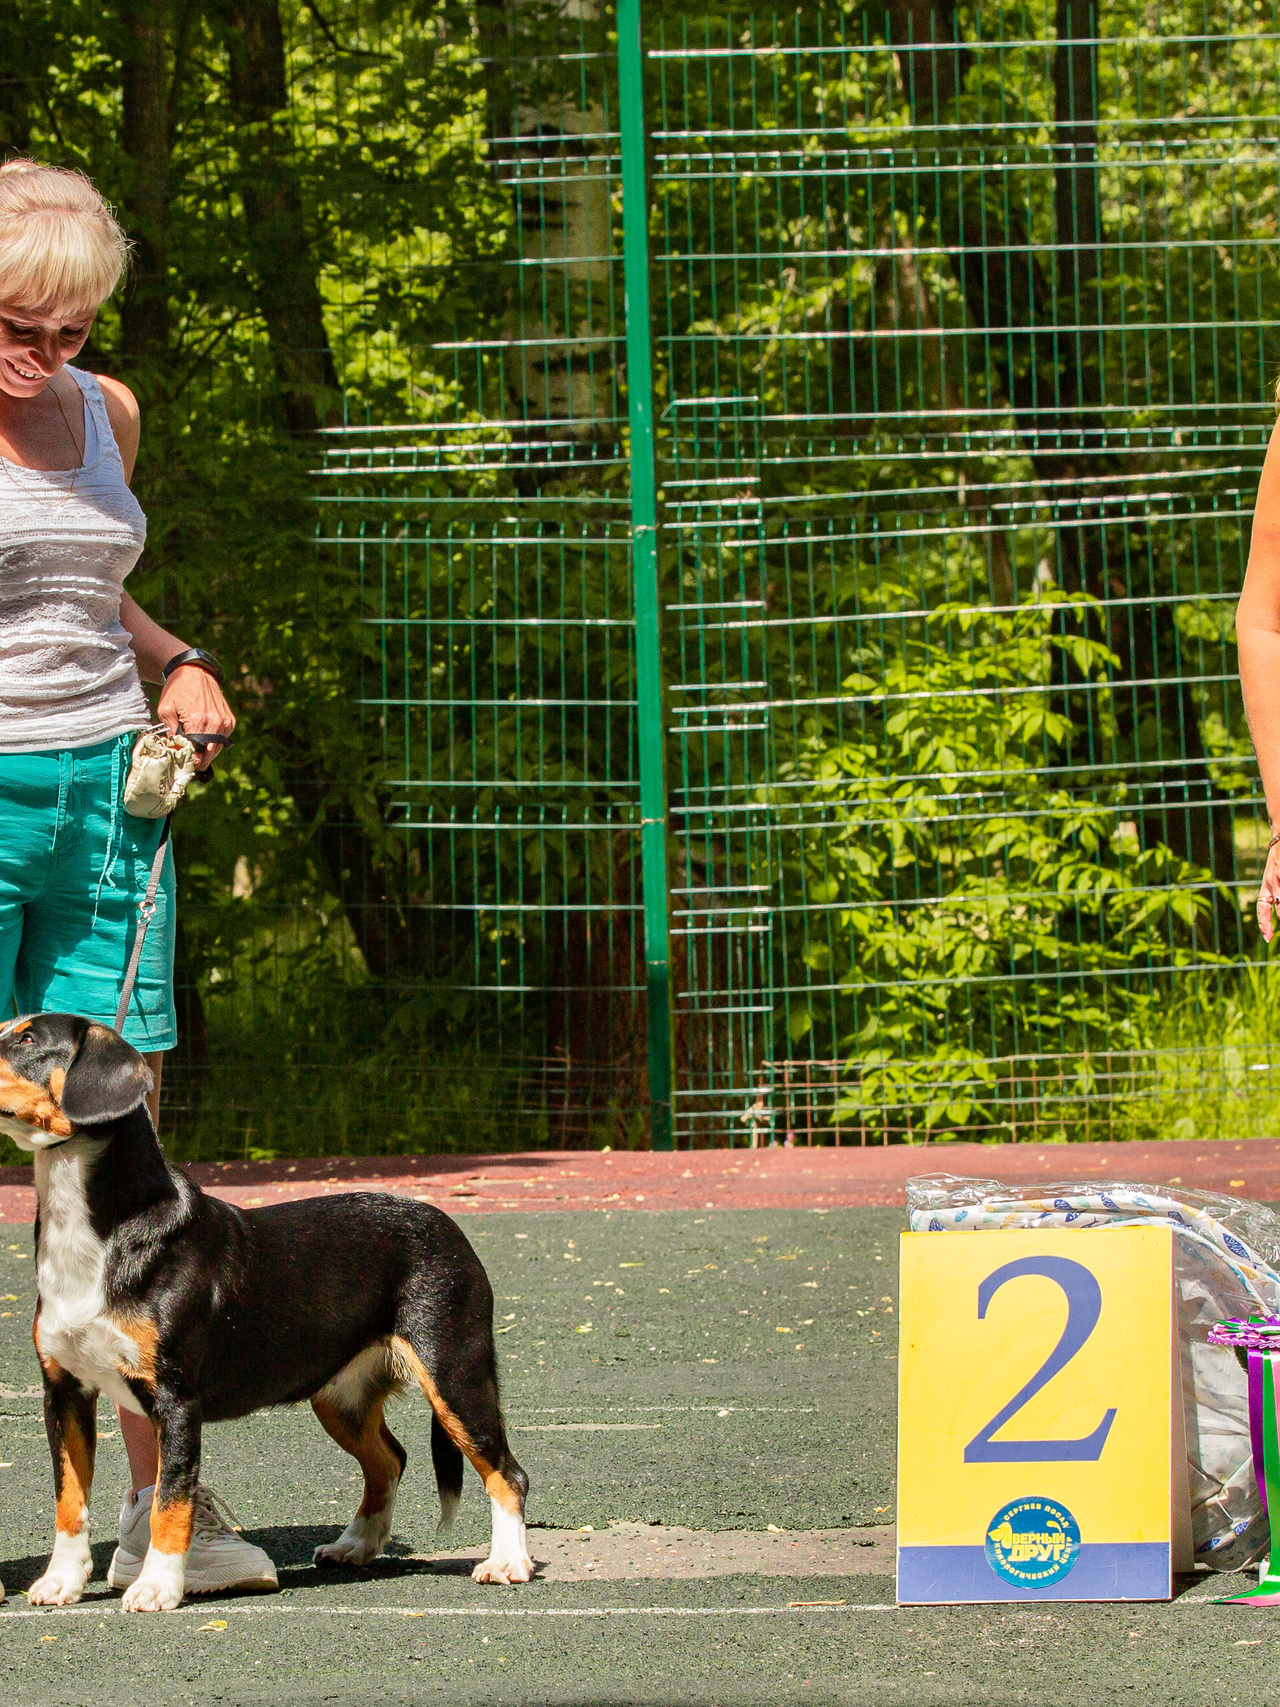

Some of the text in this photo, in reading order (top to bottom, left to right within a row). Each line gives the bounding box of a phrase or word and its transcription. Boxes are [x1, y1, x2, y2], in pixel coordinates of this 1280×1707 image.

[964, 1255, 1118, 1464] 2
[1003, 1502, 1070, 1528] СЕРГИЕВ ПОСАД
[1012, 1532, 1066, 1545] ВЕРНЫЙ
[993, 1536, 1073, 1580] КИНОЛОГИЧЕСКИЙ ЦЕНТР
[1008, 1544, 1065, 1562] ДРУГ
